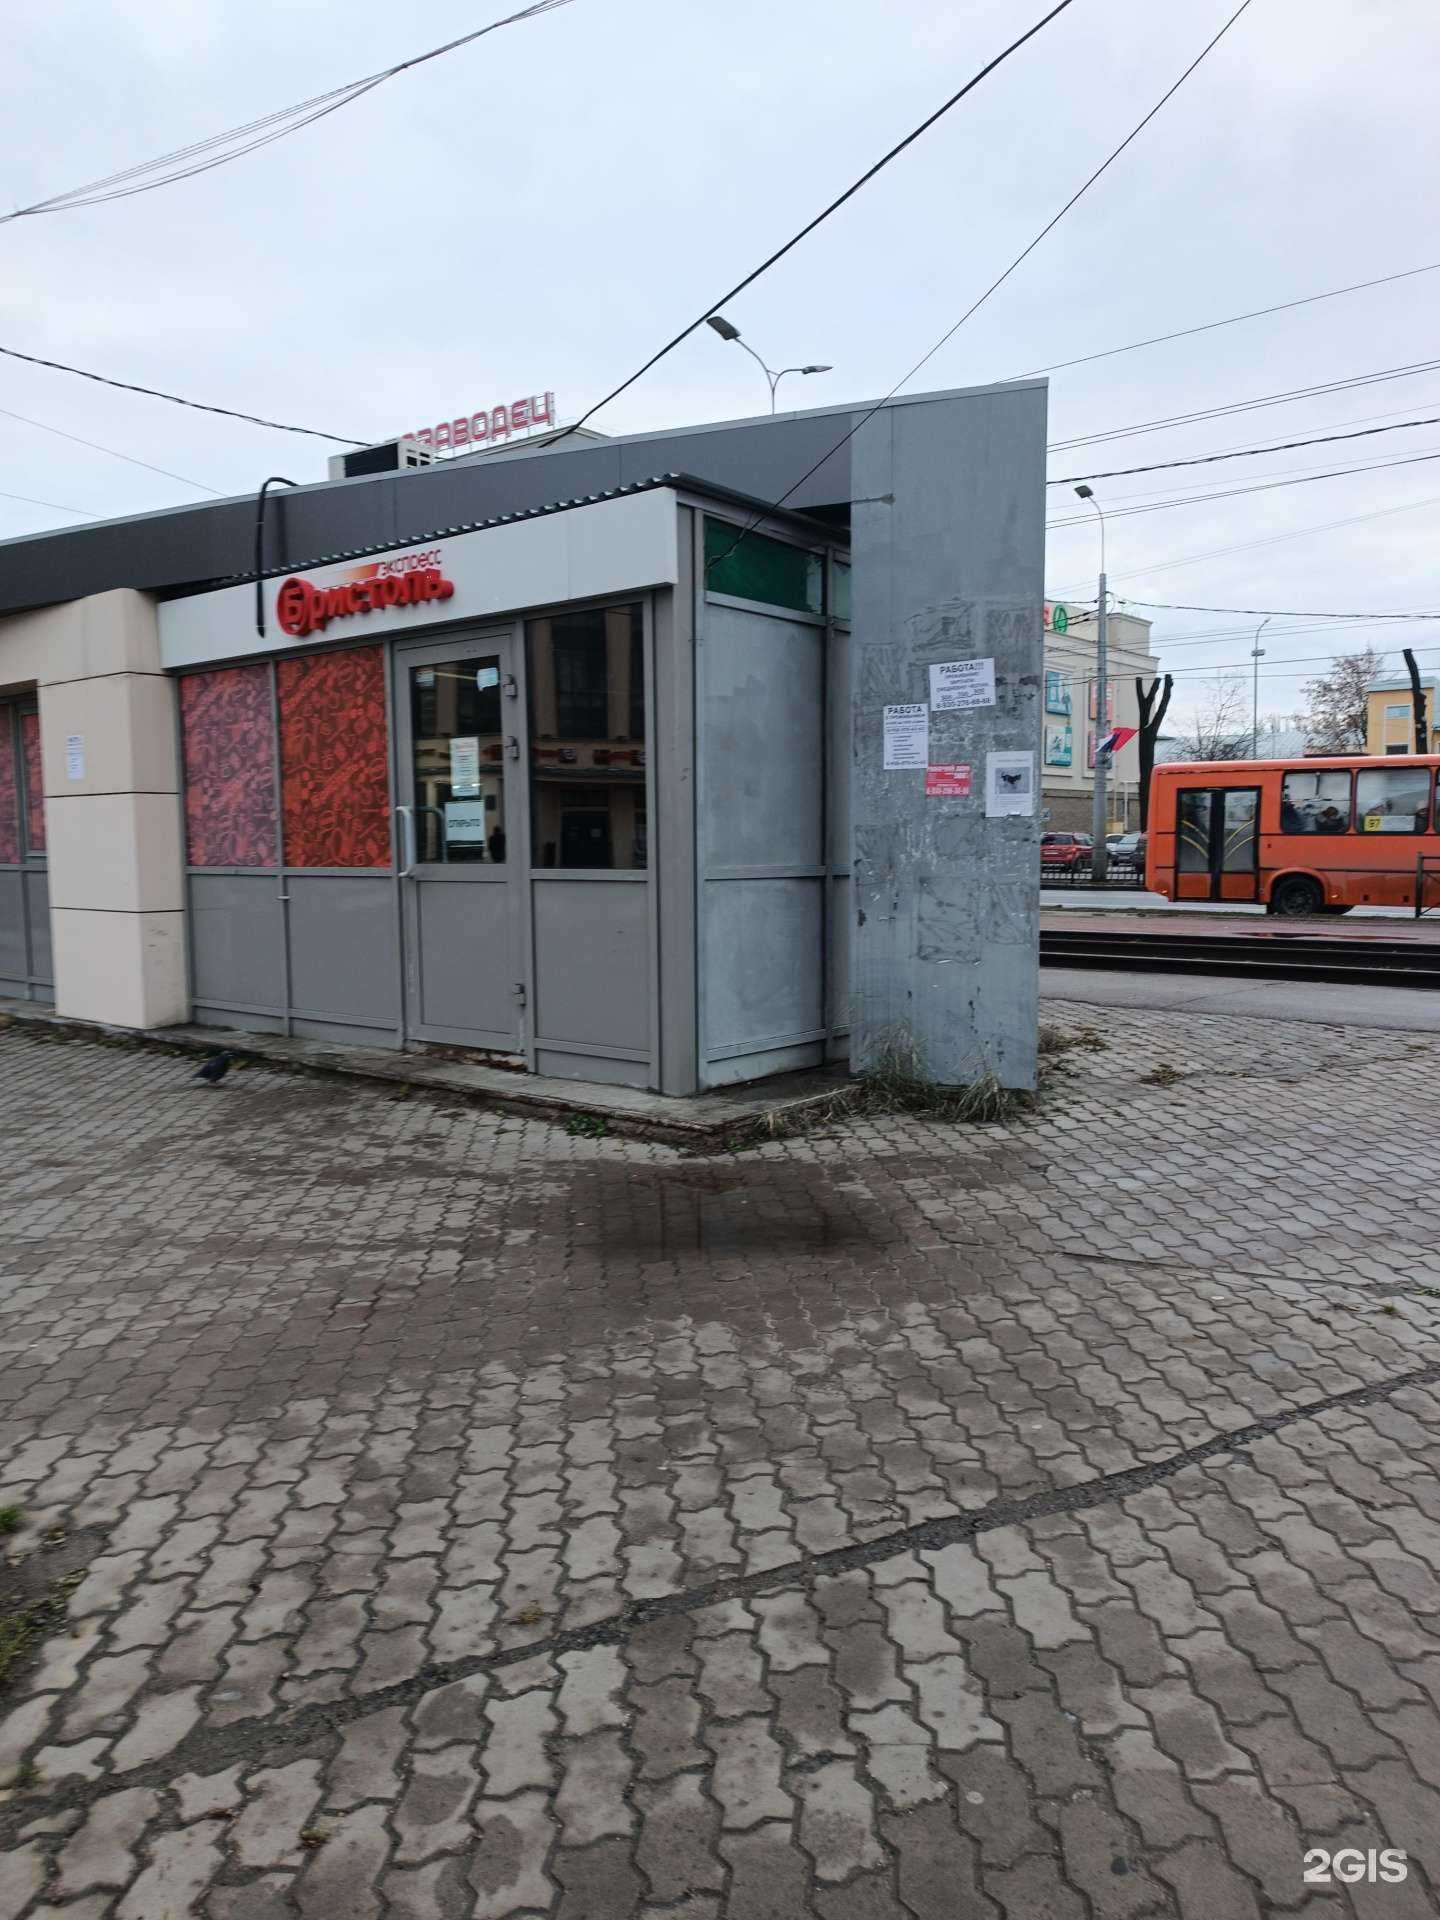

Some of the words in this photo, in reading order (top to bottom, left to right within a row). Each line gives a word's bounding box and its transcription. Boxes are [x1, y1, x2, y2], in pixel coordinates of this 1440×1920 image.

[402, 391, 553, 446] ЗАВОДЕЦ
[277, 577, 455, 635] Бристоль
[887, 705, 921, 714] РАБОТА
